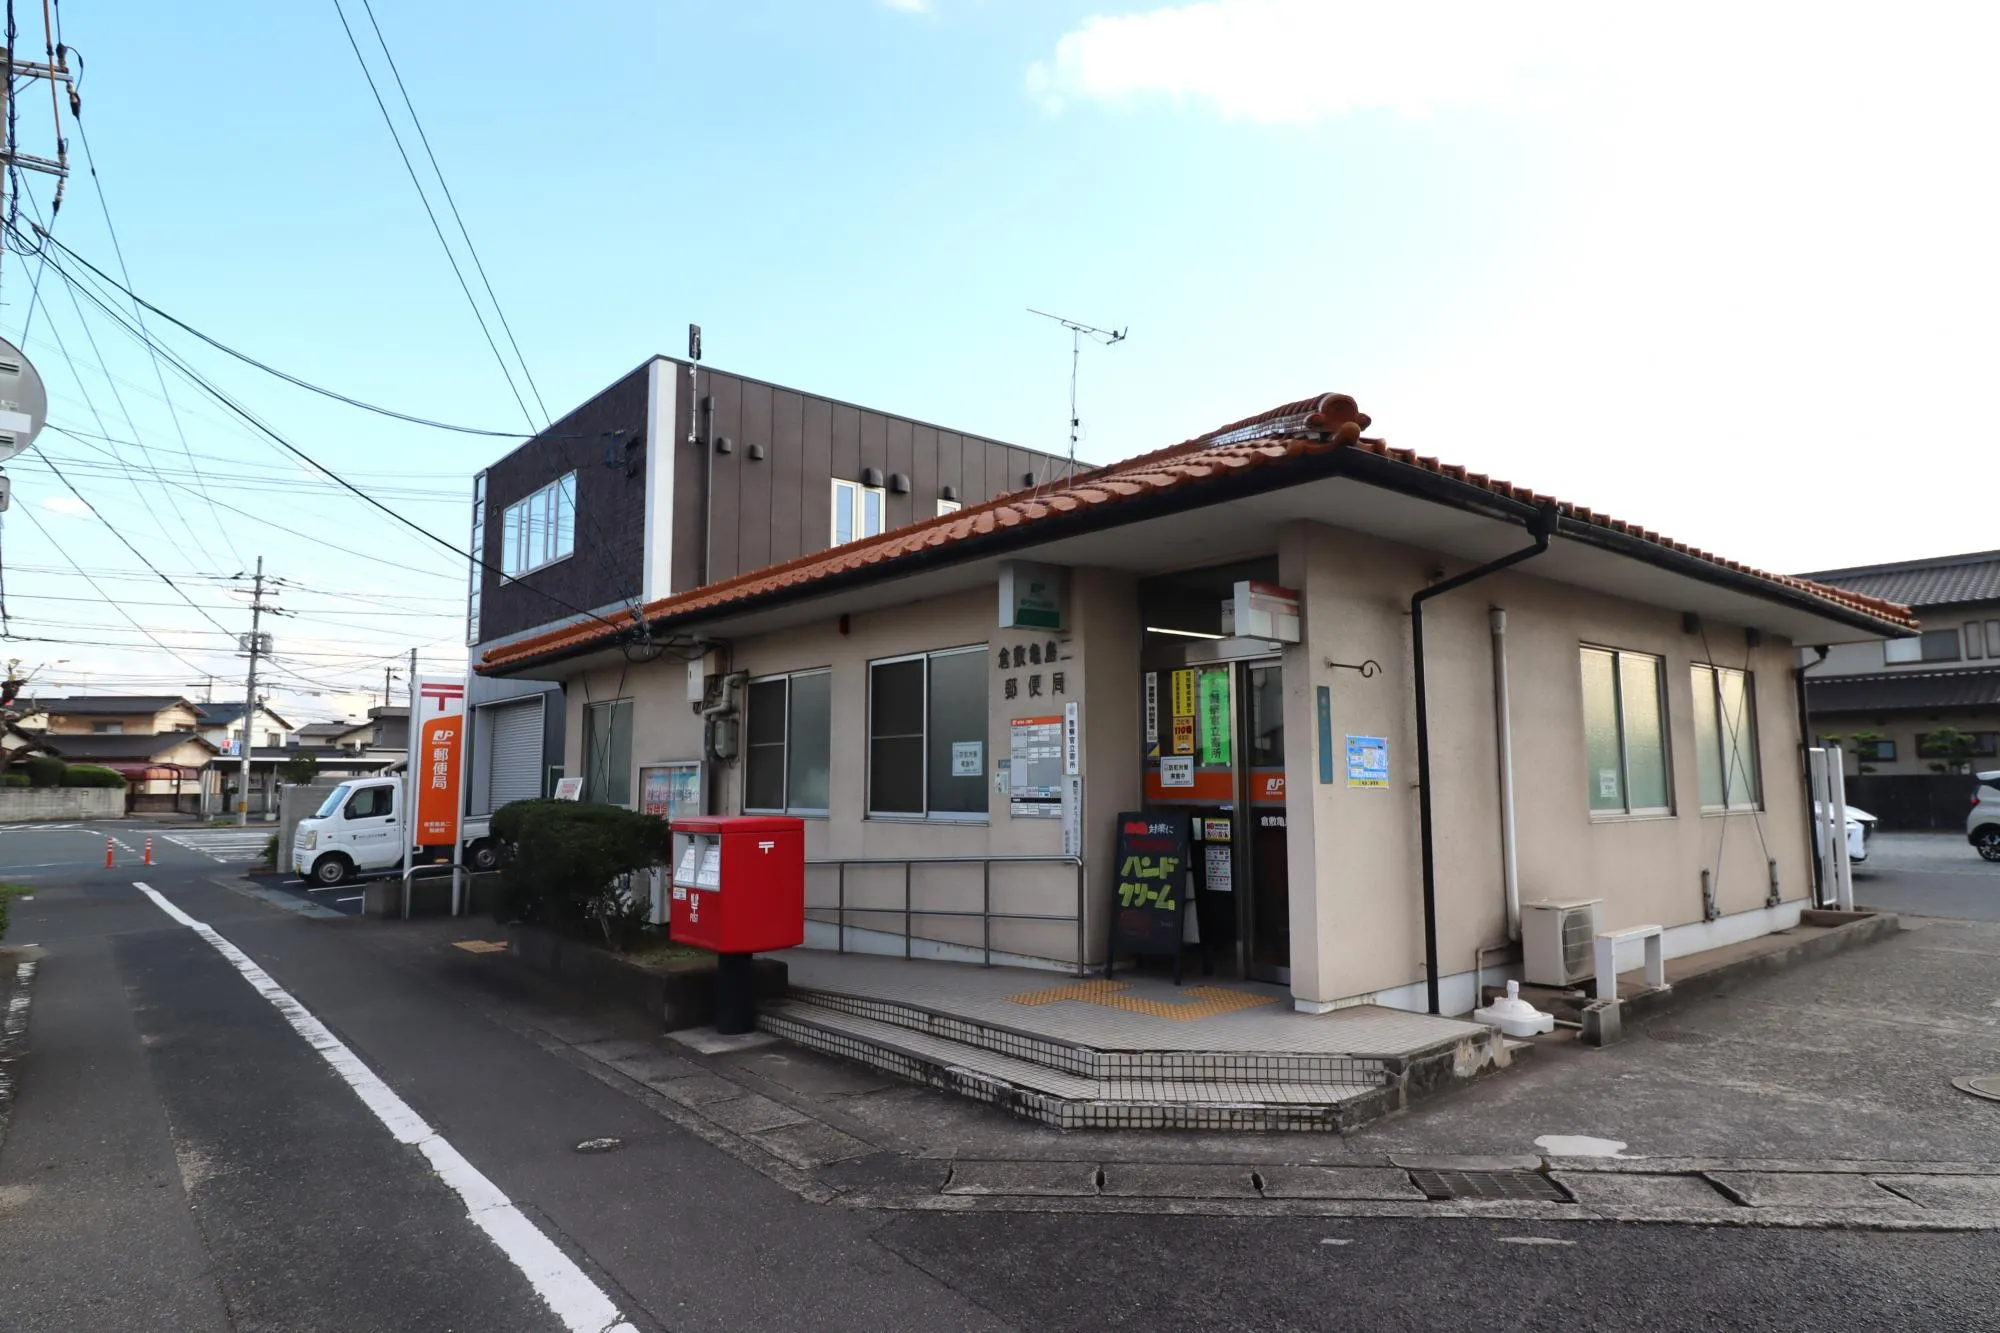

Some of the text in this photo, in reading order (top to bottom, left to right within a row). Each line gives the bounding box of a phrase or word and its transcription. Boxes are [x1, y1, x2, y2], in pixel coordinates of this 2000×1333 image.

[1004, 671, 1066, 700] 郵便局
[1175, 725, 1192, 735] 110番
[1209, 692, 1222, 759] 警察官立寄所
[1068, 719, 1076, 769] 警察官立寄所
[432, 748, 448, 789] 郵便局
[1260, 815, 1288, 827] 倉敷亀
[1120, 855, 1179, 879] ハンド
[1118, 883, 1176, 911] クリーム
